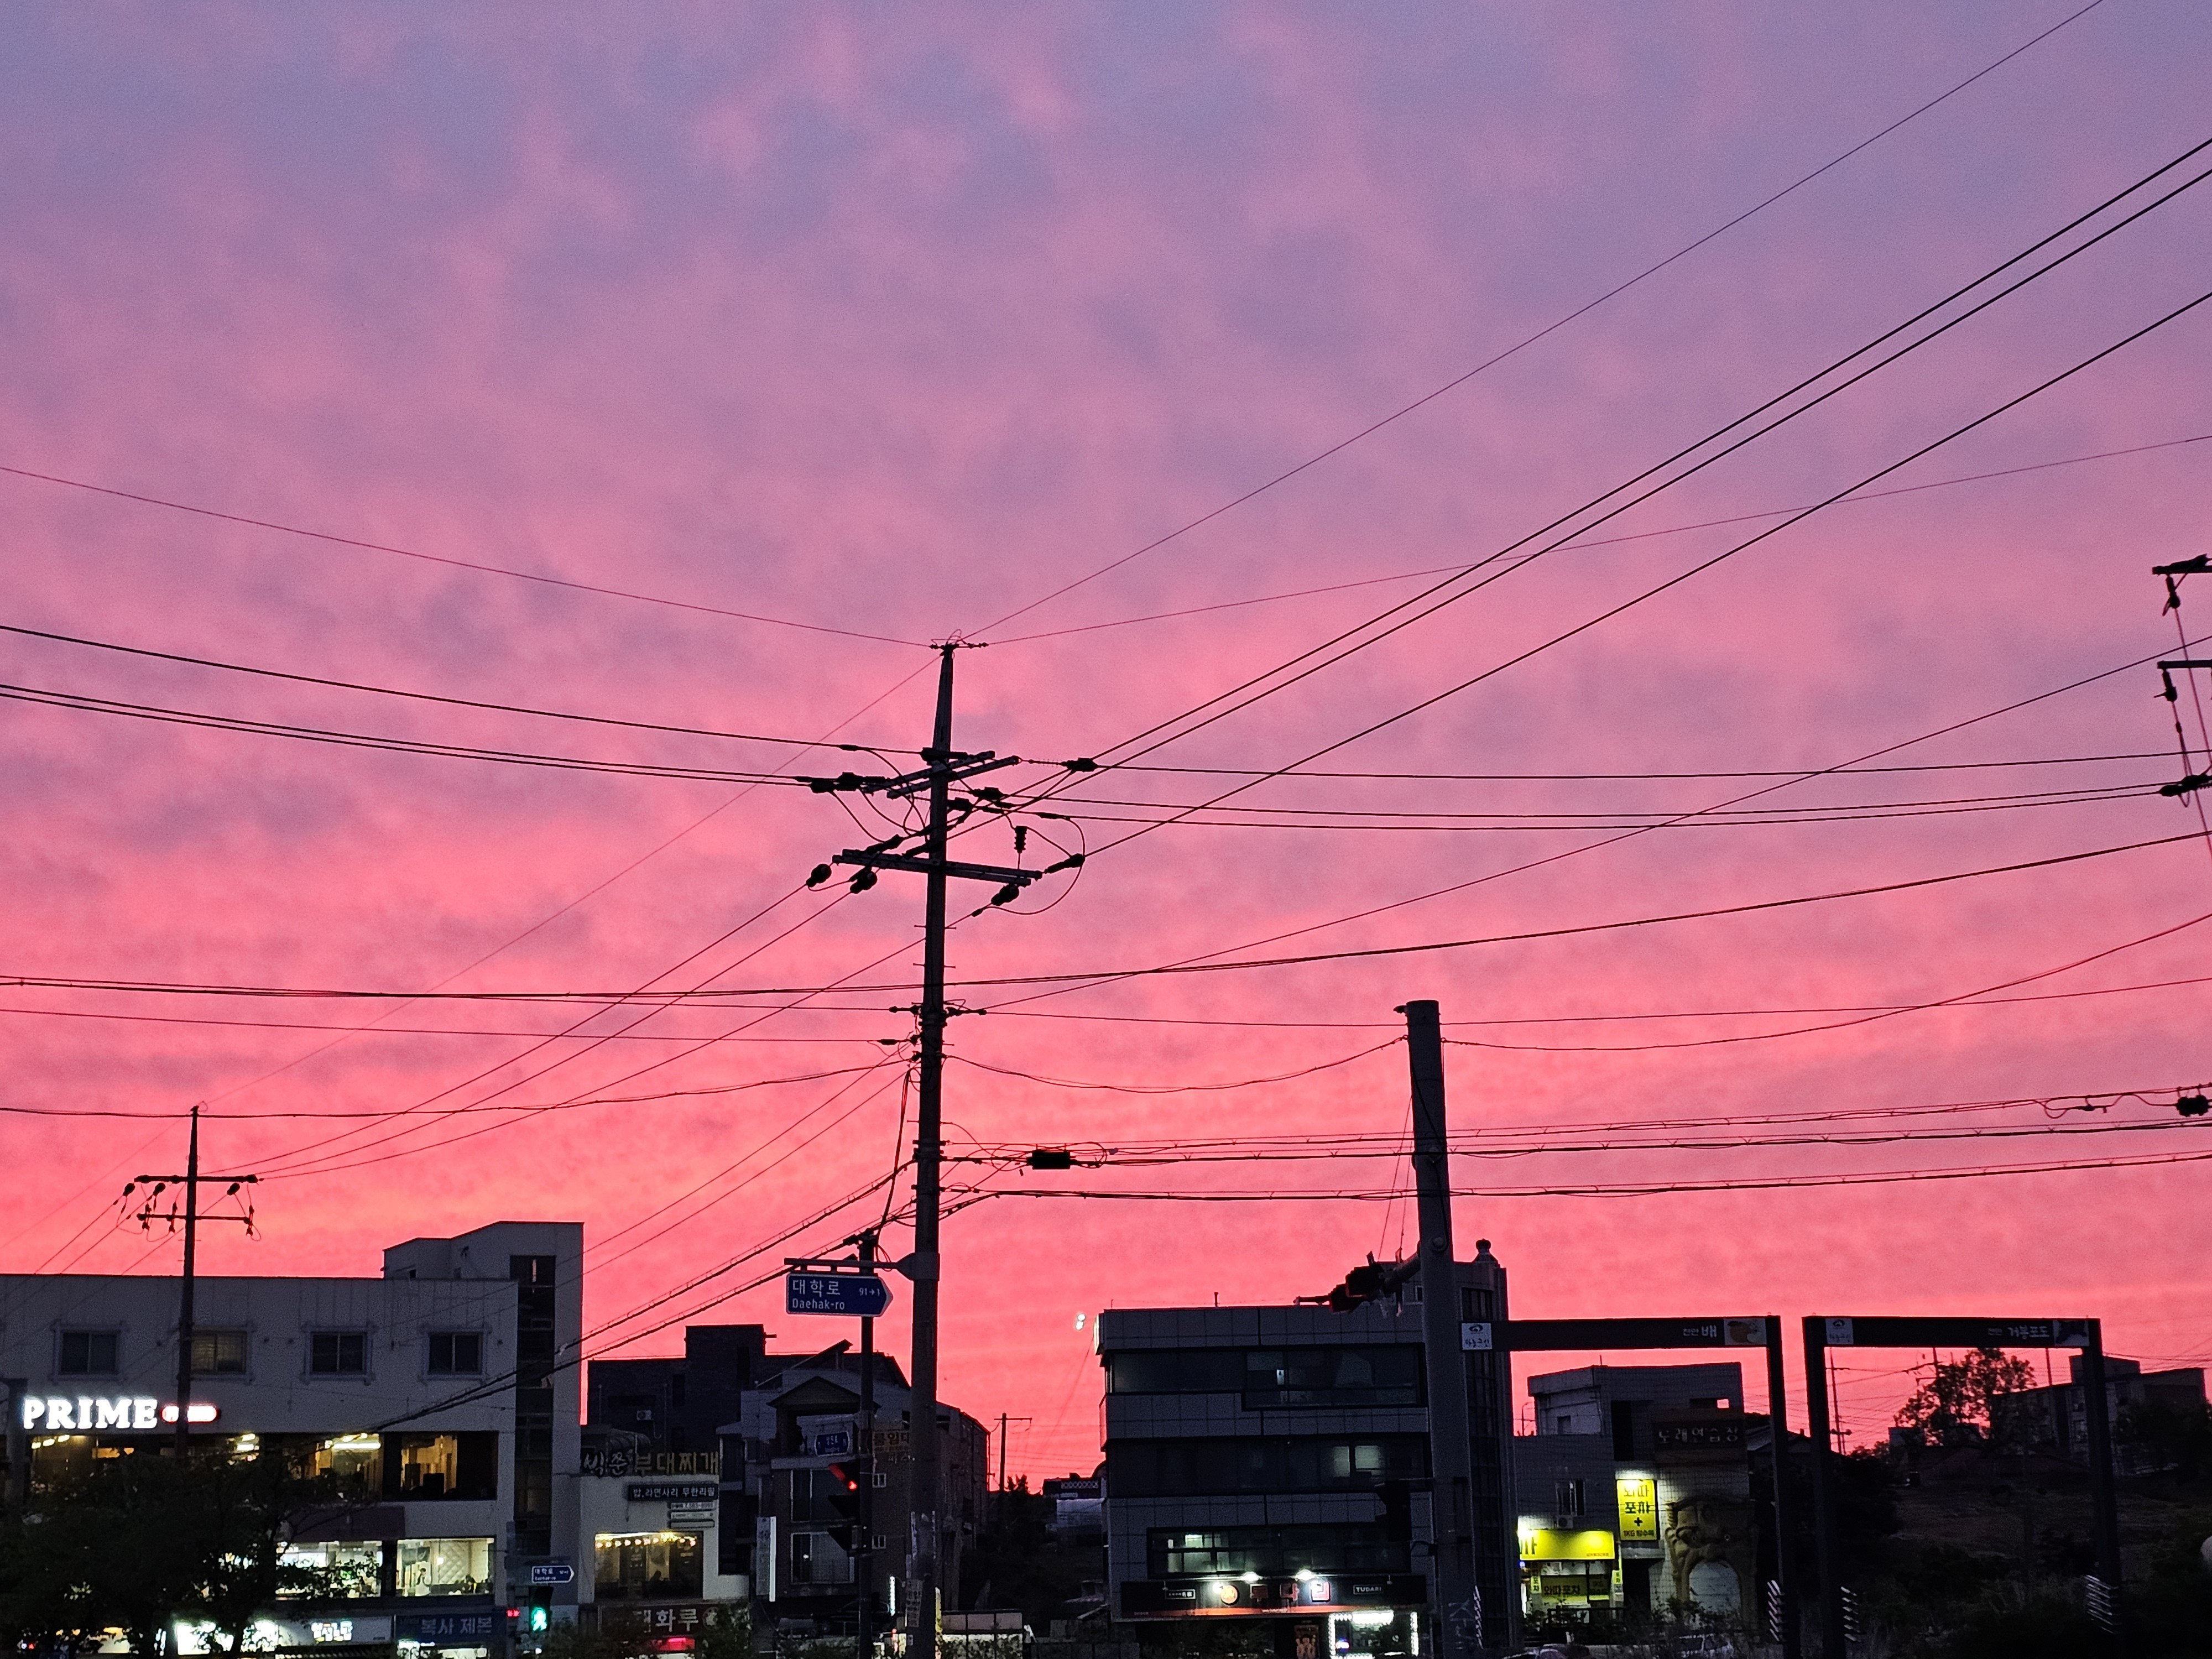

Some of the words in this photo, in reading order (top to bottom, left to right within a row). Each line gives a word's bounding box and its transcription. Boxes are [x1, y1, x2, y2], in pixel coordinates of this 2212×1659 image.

[792, 1280, 840, 1297] 대학로
[792, 1298, 845, 1310] Daehak-ro
[1702, 1325, 1717, 1338] 배
[23, 1399, 158, 1430] PRIME
[636, 1451, 718, 1477] 부대찌개
[421, 1618, 454, 1636] 복사
[460, 1616, 492, 1634] 제본
